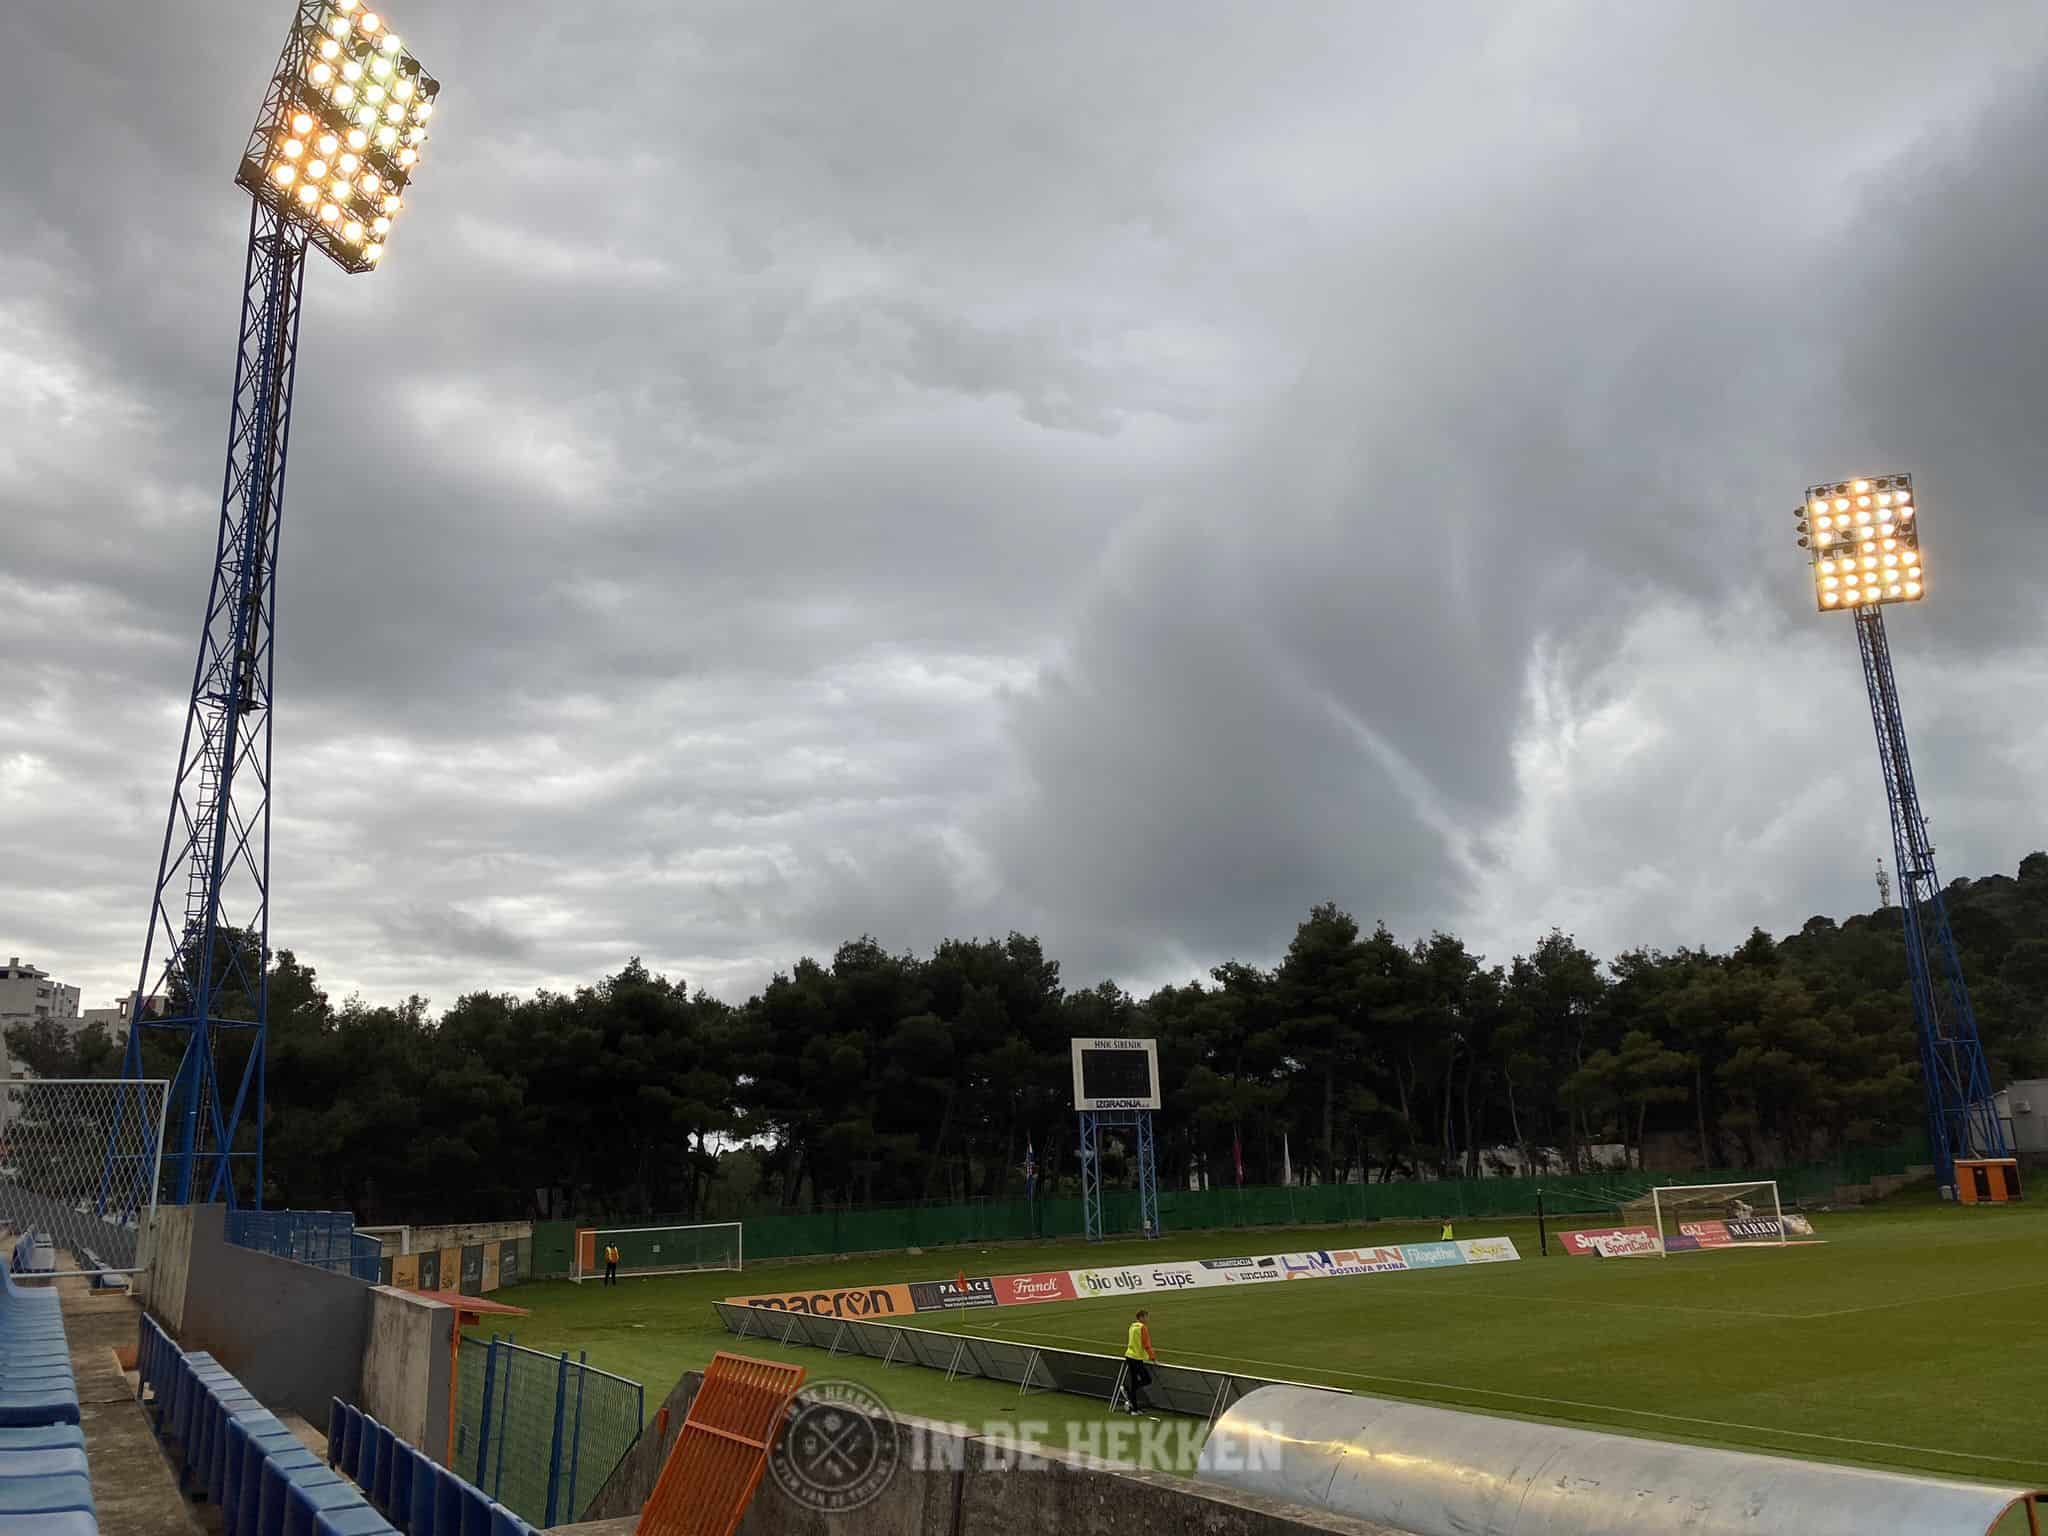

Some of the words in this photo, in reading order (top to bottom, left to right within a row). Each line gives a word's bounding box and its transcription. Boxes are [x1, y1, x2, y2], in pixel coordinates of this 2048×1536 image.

[1329, 1265, 1374, 1275] DOSTAVA
[1376, 1262, 1408, 1272] PLINA
[1013, 1277, 1058, 1294] Franck
[1086, 1273, 1112, 1290] bio
[1114, 1271, 1143, 1290] ulja
[748, 1289, 894, 1318] macron
